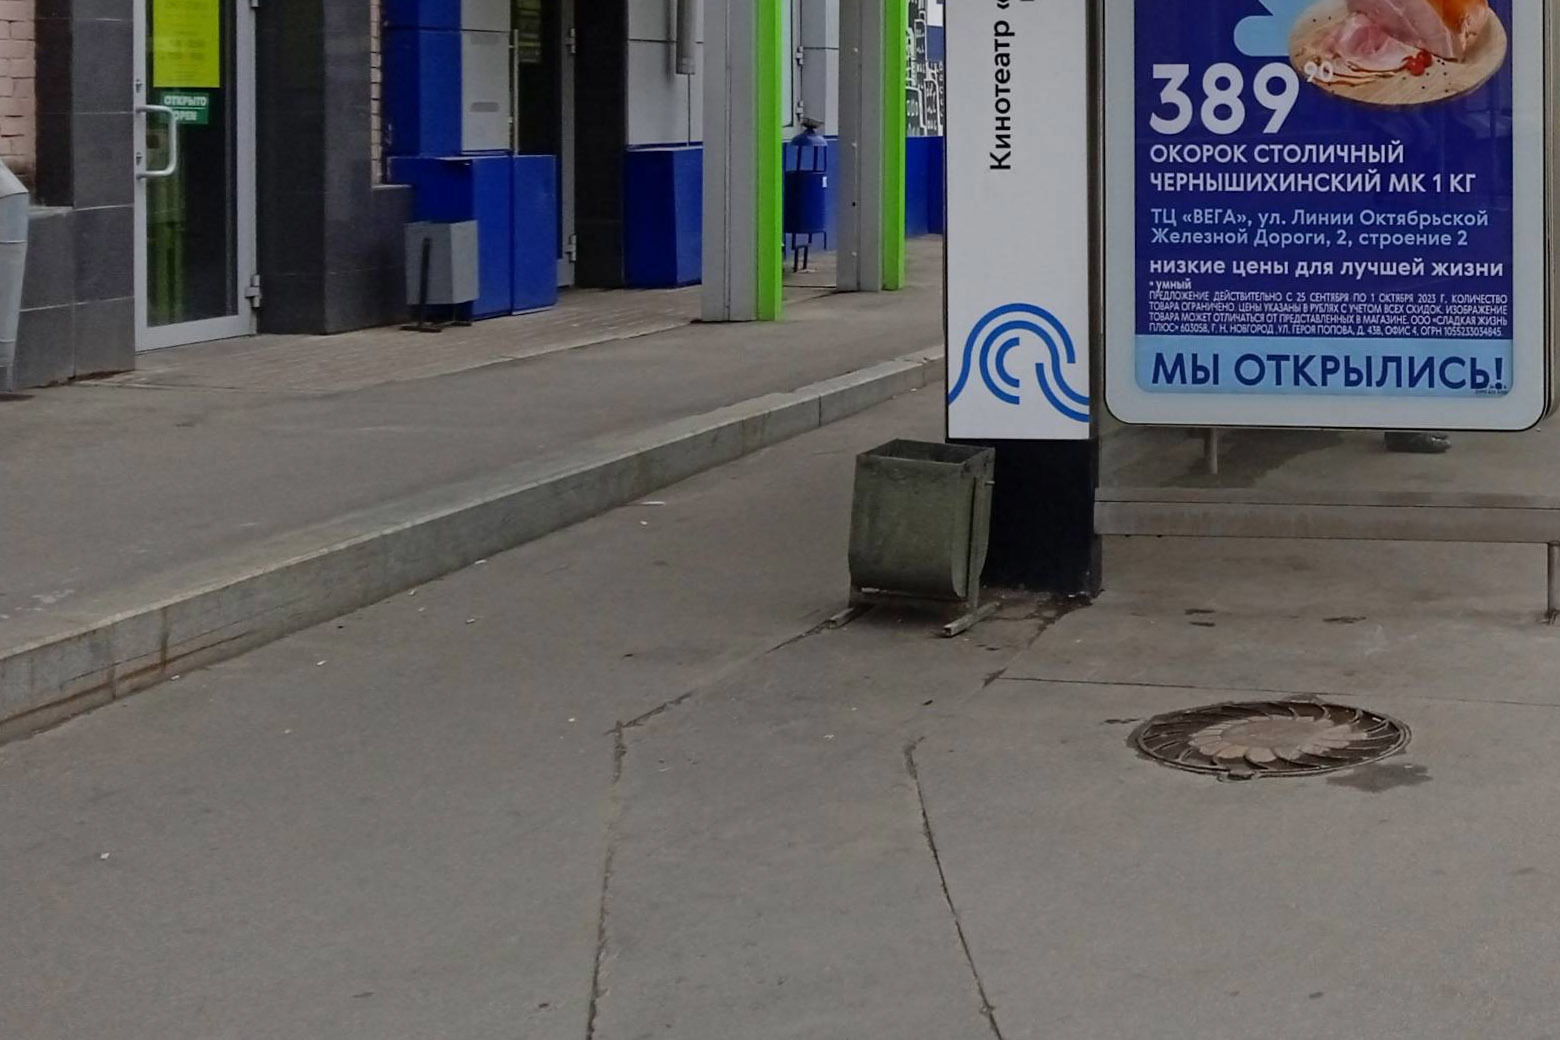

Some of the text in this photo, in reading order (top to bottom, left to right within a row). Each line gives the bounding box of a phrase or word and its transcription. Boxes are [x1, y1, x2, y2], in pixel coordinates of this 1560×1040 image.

[163, 95, 208, 107] ОТКРЫТО
[988, 19, 1016, 171] Кинотеатр
[1149, 61, 1334, 135] 389 90
[1150, 140, 1404, 164] ОКОРОК СТОЛИЧНЫЙ
[1150, 169, 1477, 193] ЧЕРНЫШИХИНСКИЙ МК 1 КГ
[1151, 208, 1489, 230] ТЦ «ВЕГА», ул. Линии Октябрьской
[1151, 227, 1469, 250] Железной Дороги, 2, строение 2
[1150, 257, 1504, 280] низкие цены для лучшей жизни
[1149, 290, 1209, 301] ПРЕДЛОЖЕНИЕ
[1213, 290, 1283, 302] ДЕЙСТВИТЕЛЬНО
[1286, 291, 1293, 302] С
[1296, 292, 1306, 302] 25
[1309, 292, 1349, 302] СЕНТЯБРЯ
[1353, 293, 1367, 303] ПО
[1378, 293, 1414, 303] ОКТЯБРЯ
[1418, 293, 1436, 303] 2023
[1451, 294, 1508, 304] КОЛИЧЕСТВО
[1149, 301, 1180, 311] ТОВАРА
[1238, 302, 1262, 312] ЦЕНЫ
[1264, 302, 1301, 313] УКАЗАНЫ
[1303, 303, 1308, 313] В
[1310, 303, 1339, 313] РУБЛЯХ
[1340, 304, 1347, 313] С
[1349, 304, 1382, 314] УЧЕТОМ
[1384, 304, 1404, 314] ВСЕХ
[1445, 305, 1508, 315] ИЗОБРАЖЕНИЕ
[1149, 312, 1180, 322] ТОВАРА
[1181, 312, 1212, 322] МОЖЕТ
[1213, 312, 1265, 323] ОТЛИЧАТЬСЯ
[1266, 313, 1278, 323] ОТ
[1279, 314, 1355, 324] ПРЕДСТАВЛЕННЫХ
[1356, 315, 1361, 324] В
[1410, 315, 1431, 325] ООО
[1477, 316, 1508, 326] ЖИЗНЬ
[1230, 324, 1274, 335] НОВГОРОД
[1292, 325, 1316, 335] ГЕРОЯ
[1385, 326, 1411, 336] ОФИС
[1420, 326, 1442, 336] ОГРН
[1151, 352, 1504, 390] МЫ ОТКРЫЛИСЬ!
